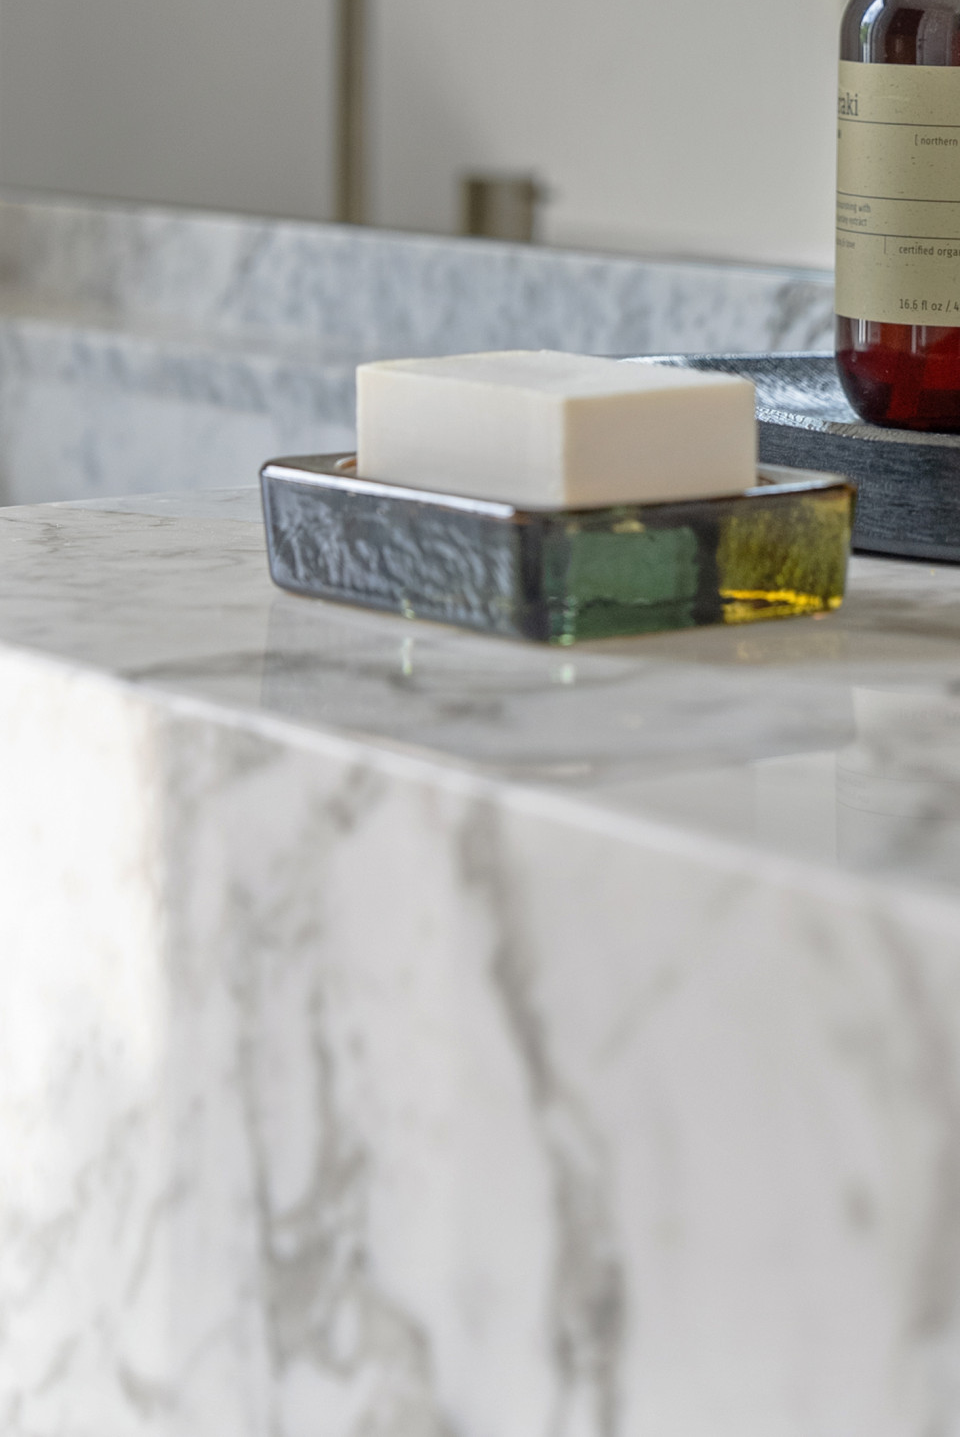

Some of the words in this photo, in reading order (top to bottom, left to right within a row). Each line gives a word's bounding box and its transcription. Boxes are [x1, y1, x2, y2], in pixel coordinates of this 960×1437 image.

[920, 137, 958, 147] northern
[899, 245, 934, 256] certified
[899, 298, 918, 310] 16.6
[921, 299, 928, 311] fl
[930, 302, 943, 312] oz
